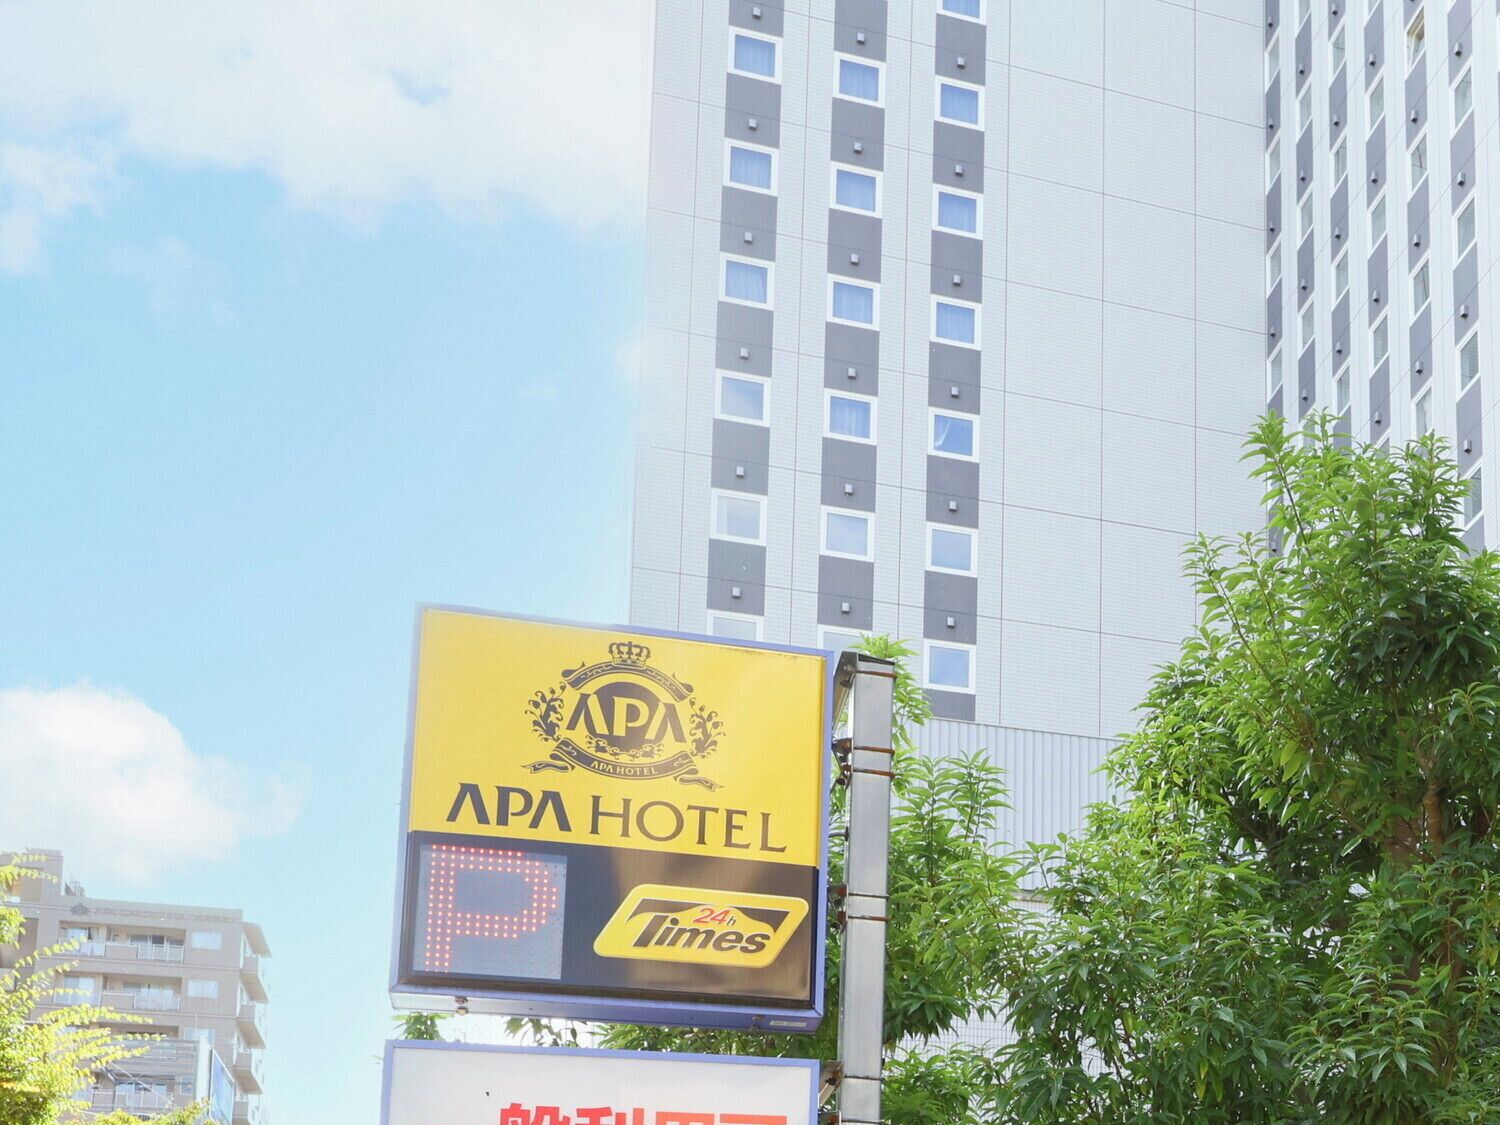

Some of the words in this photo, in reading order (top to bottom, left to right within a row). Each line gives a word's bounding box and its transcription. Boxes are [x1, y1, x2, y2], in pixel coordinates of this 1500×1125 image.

[565, 692, 687, 744] APA
[590, 760, 614, 774] APA
[616, 765, 658, 776] HOTEL
[446, 782, 572, 833] APA
[588, 794, 788, 853] HOTEL
[632, 911, 772, 955] Times
